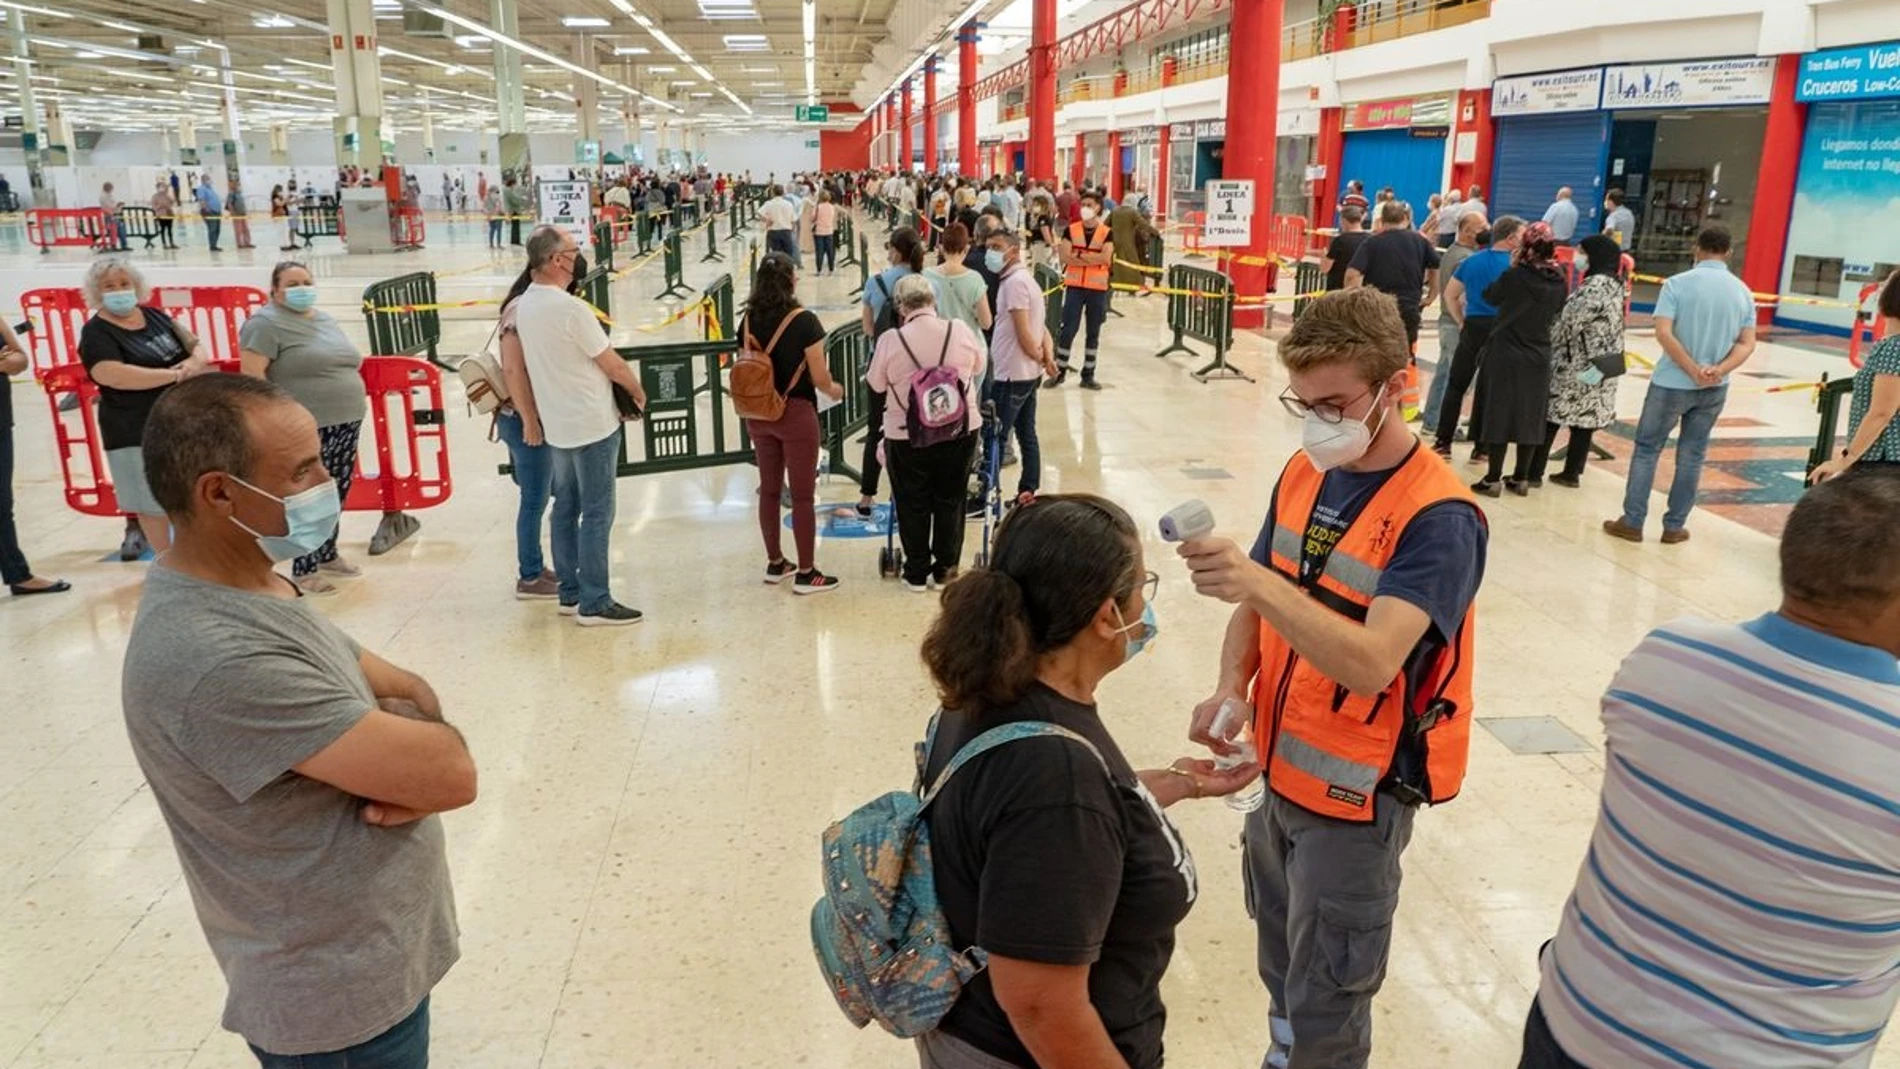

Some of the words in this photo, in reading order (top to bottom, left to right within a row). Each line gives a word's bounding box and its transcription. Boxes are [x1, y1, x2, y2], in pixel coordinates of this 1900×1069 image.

[1803, 78, 1858, 96] Cruceros
[1821, 138, 1868, 153] Llegamos
[1823, 157, 1864, 170] Internet
[1866, 159, 1880, 170] no
[550, 192, 581, 200] LINEA
[558, 200, 571, 216] 2
[1225, 199, 1234, 213] 1
